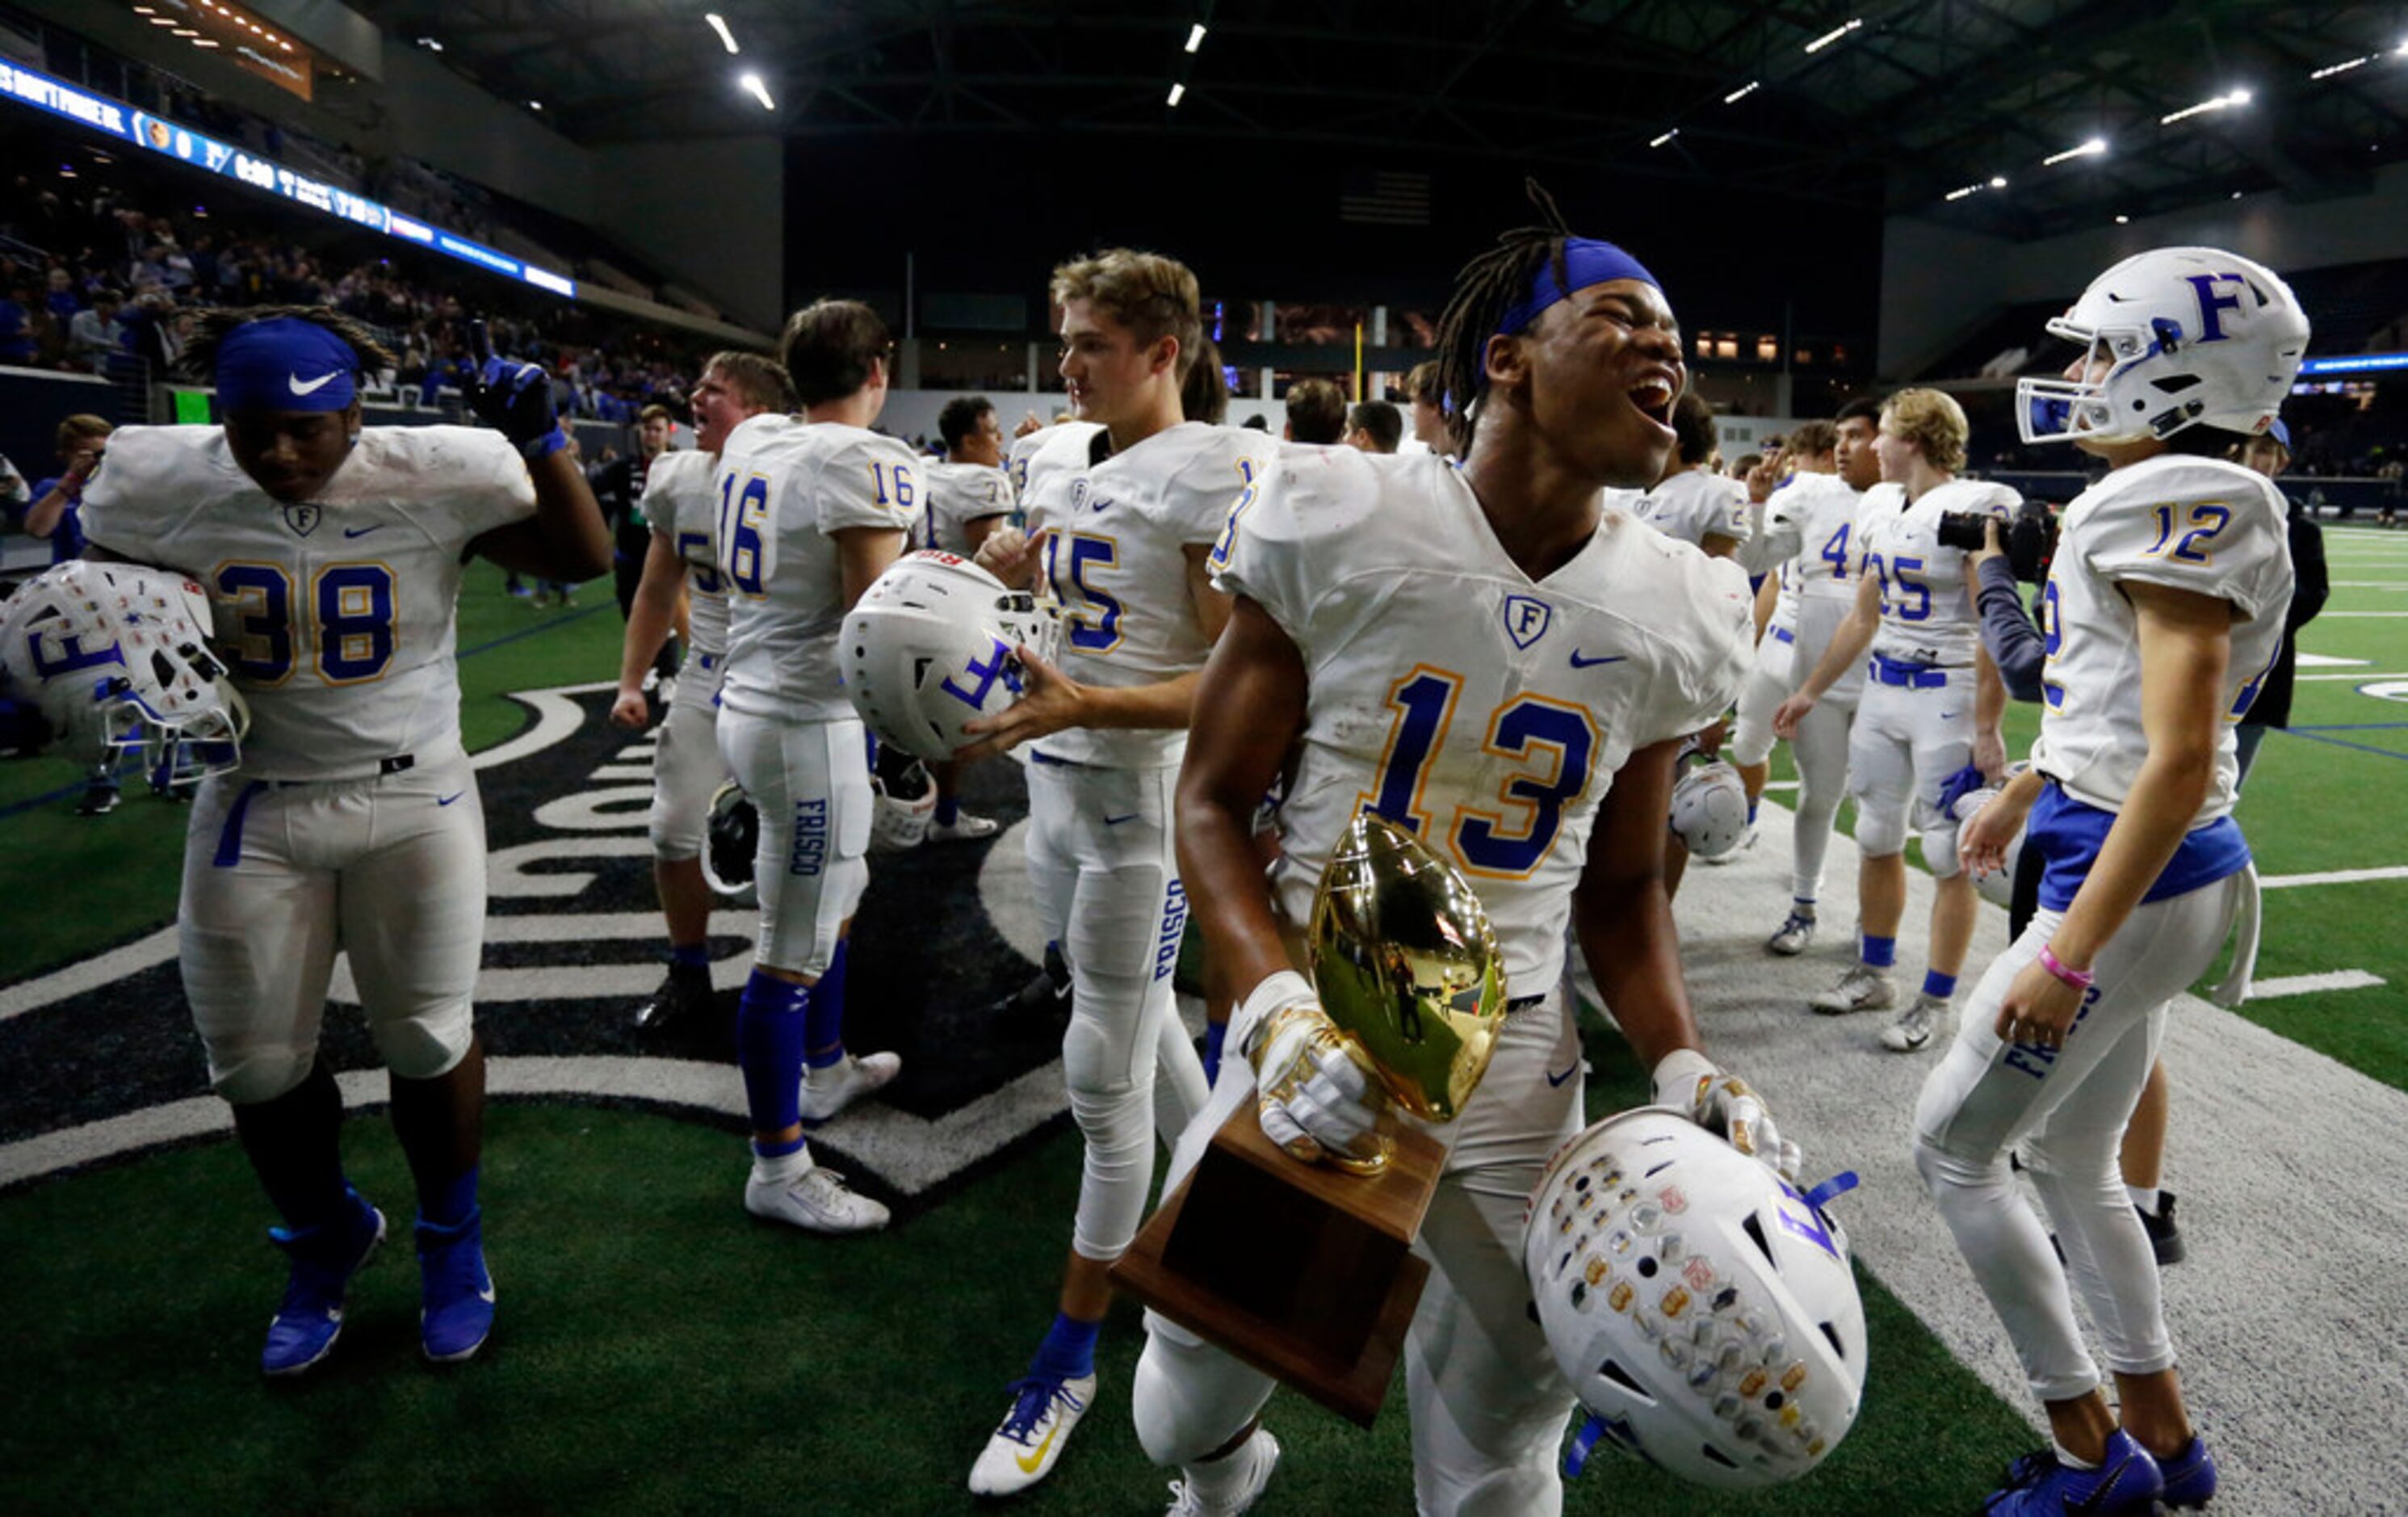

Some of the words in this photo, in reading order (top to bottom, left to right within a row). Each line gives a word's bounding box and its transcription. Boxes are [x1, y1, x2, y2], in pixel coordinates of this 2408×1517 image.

[2184, 272, 2244, 344] F
[868, 459, 915, 509] 16
[2141, 499, 2232, 566] 12
[212, 559, 401, 687] 38
[1351, 662, 1602, 881] 13
[790, 798, 826, 876] FRISCO
